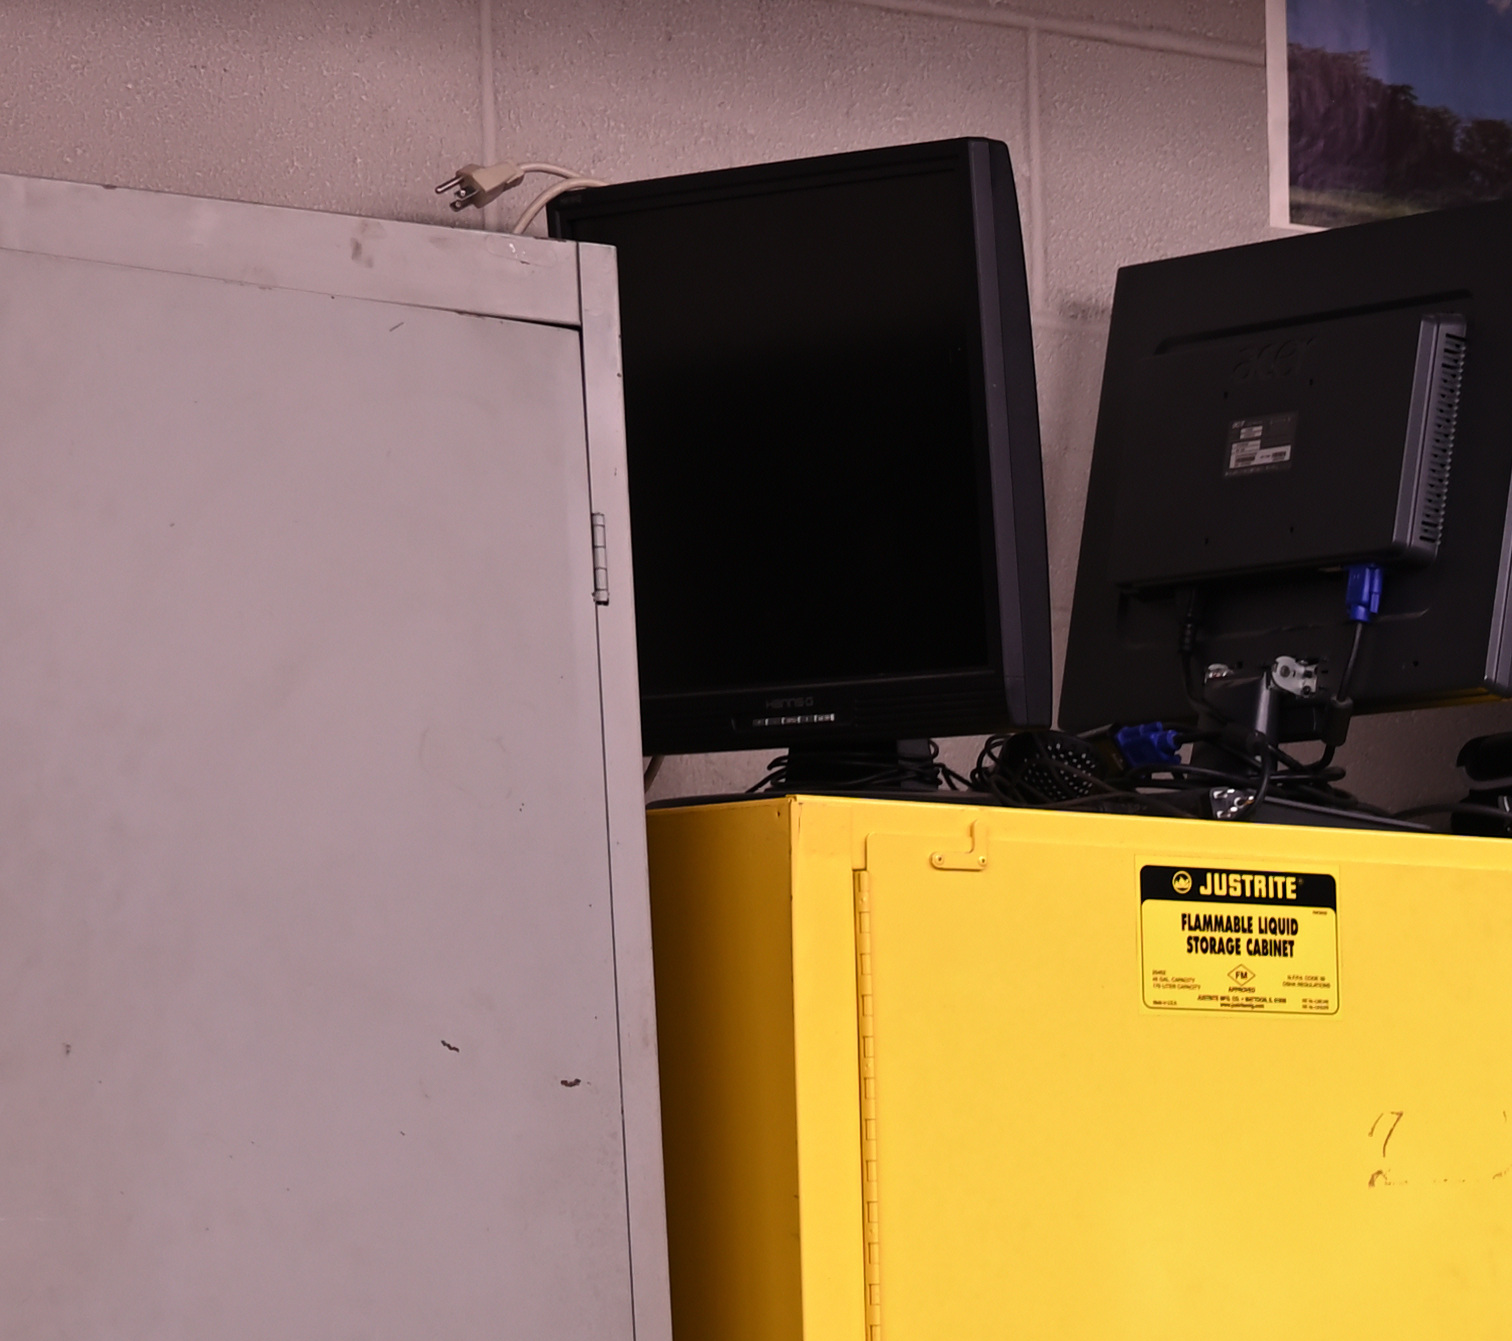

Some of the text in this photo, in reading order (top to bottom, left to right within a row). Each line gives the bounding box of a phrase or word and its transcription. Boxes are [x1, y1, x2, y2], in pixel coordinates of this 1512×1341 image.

[1199, 872, 1298, 900] JUSTRITE
[1181, 913, 1298, 937] FLAMMABLE LIQUID
[1186, 936, 1295, 958] STORAGE CABINET
[1235, 971, 1248, 979] FM
